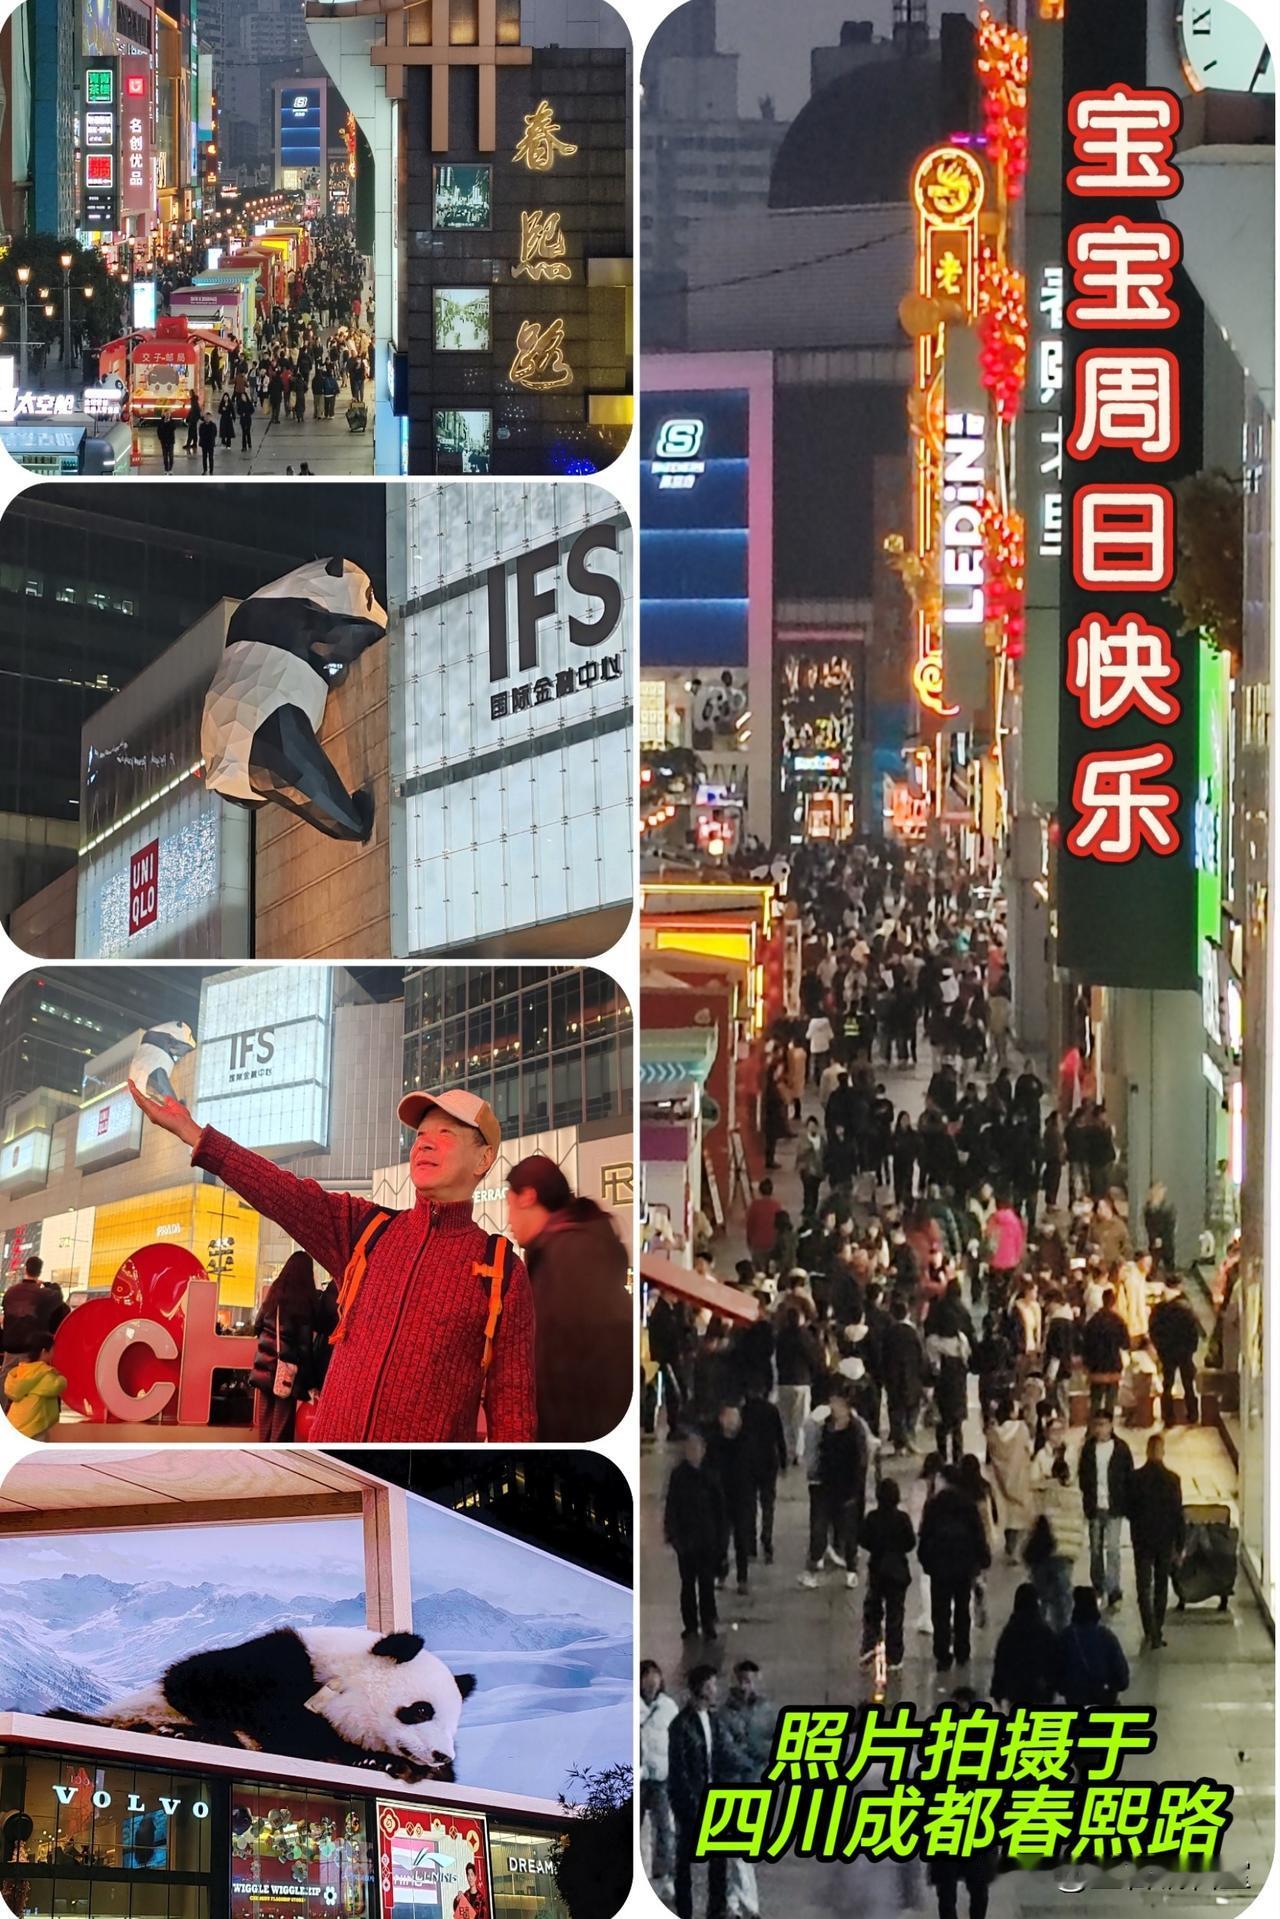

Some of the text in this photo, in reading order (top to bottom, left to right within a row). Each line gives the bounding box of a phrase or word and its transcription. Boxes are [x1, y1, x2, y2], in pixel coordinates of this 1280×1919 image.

[129, 117, 144, 187] 名创优品
[487, 523, 623, 683] IFS
[133, 852, 154, 890] UNI
[132, 885, 155, 925] QLO
[229, 1026, 275, 1070] IFS
[52, 1784, 210, 1819] VOLVO
